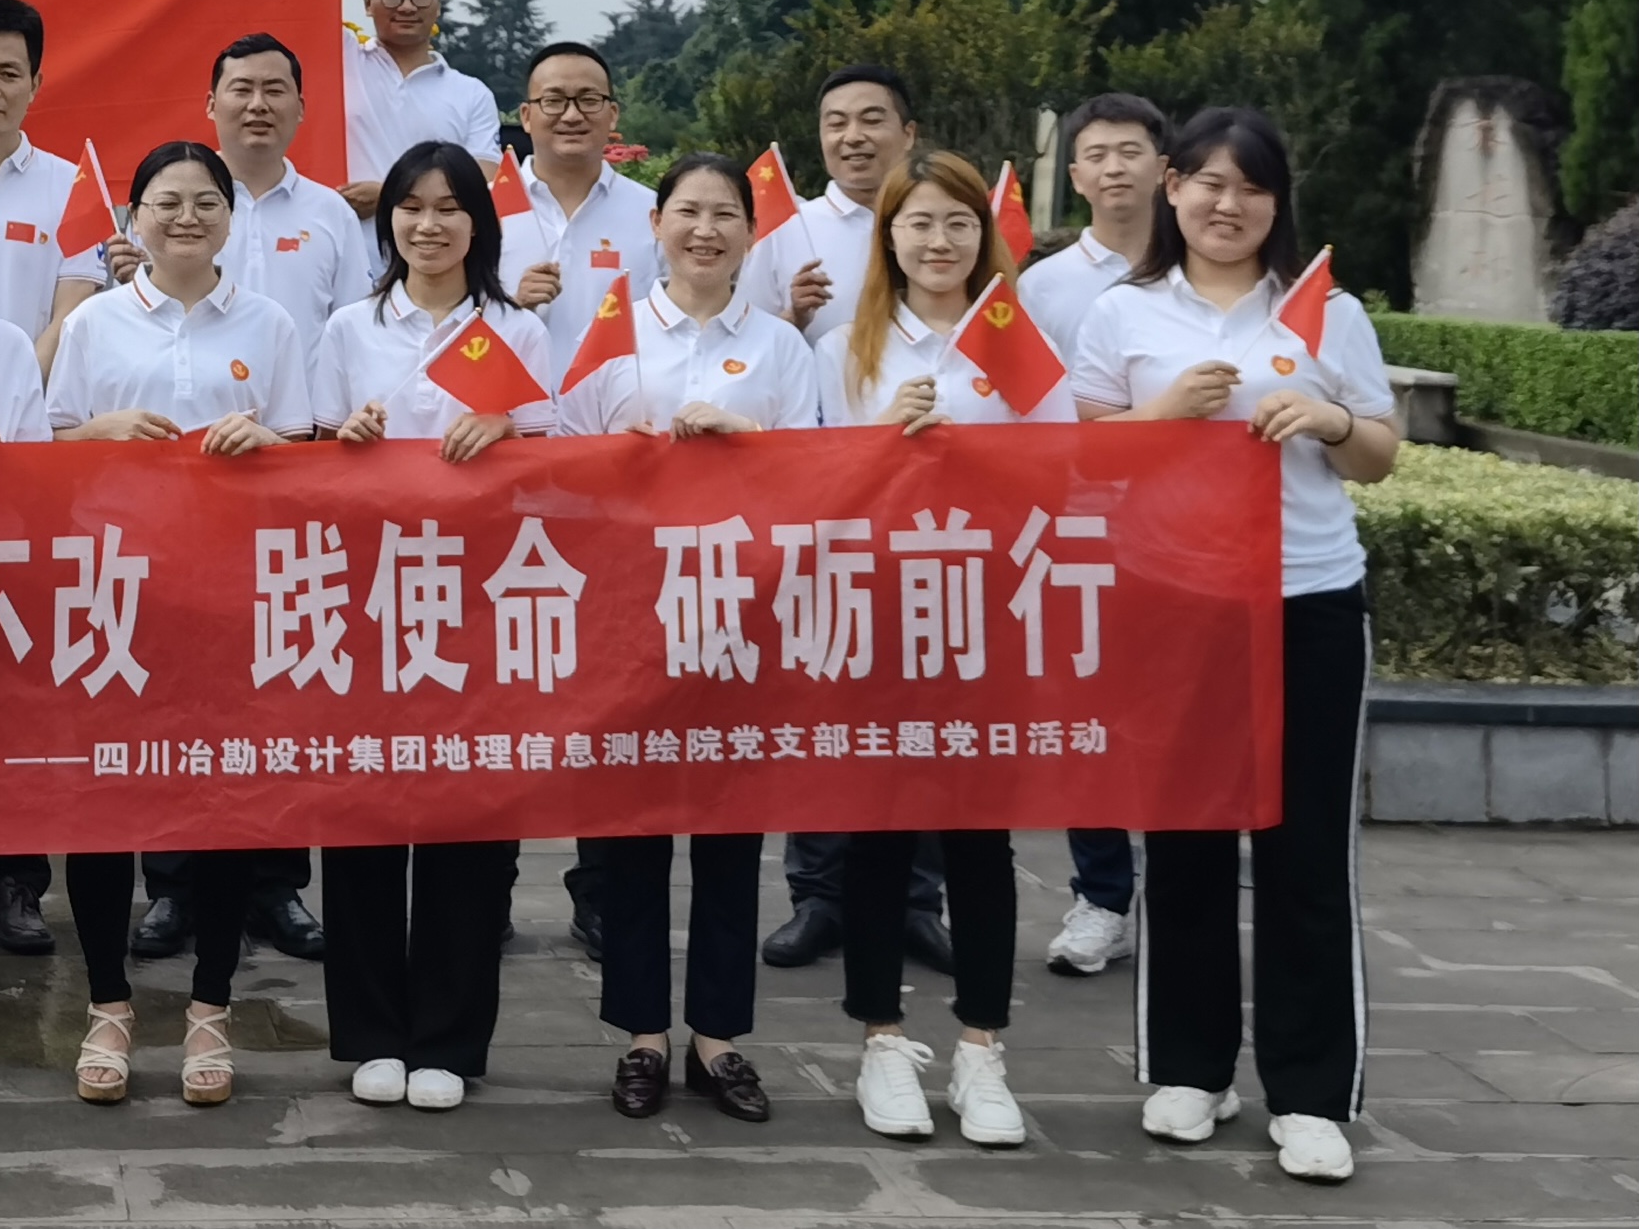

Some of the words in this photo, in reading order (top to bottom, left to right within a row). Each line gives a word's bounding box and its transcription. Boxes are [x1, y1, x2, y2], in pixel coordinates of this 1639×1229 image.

[250, 517, 587, 695] 践使命
[654, 506, 1116, 683] 砥砺前行
